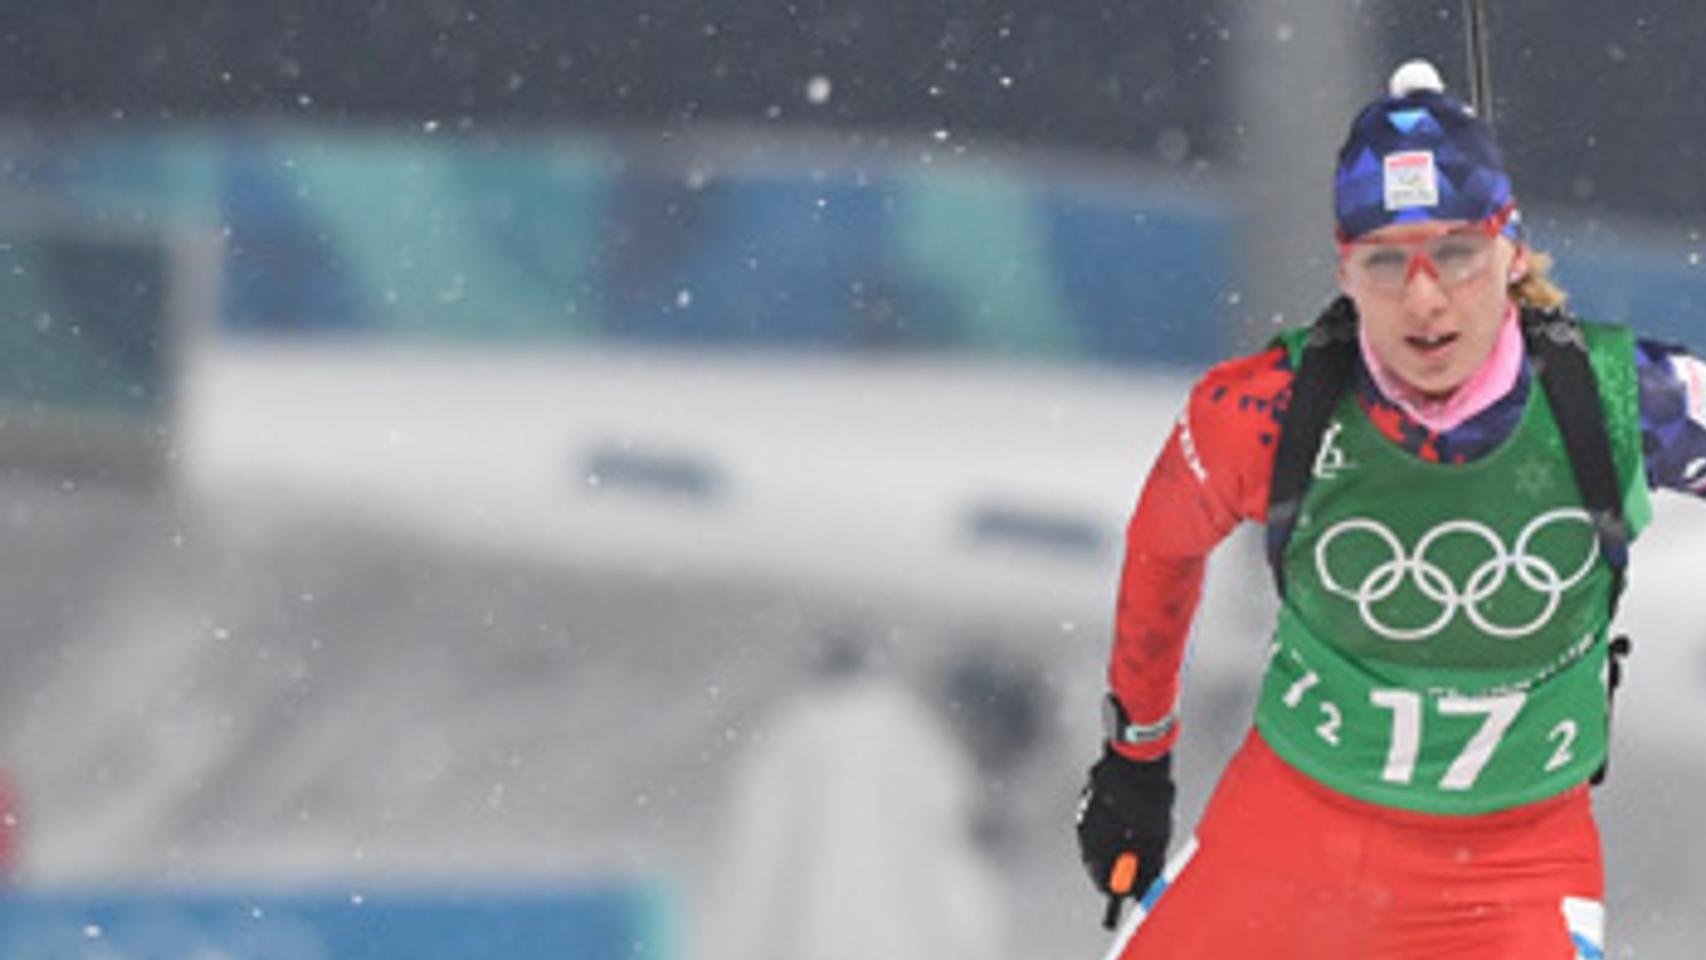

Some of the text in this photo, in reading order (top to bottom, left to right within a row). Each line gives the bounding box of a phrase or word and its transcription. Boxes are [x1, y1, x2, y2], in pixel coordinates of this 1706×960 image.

[1316, 688, 1577, 790] 2 17 2
